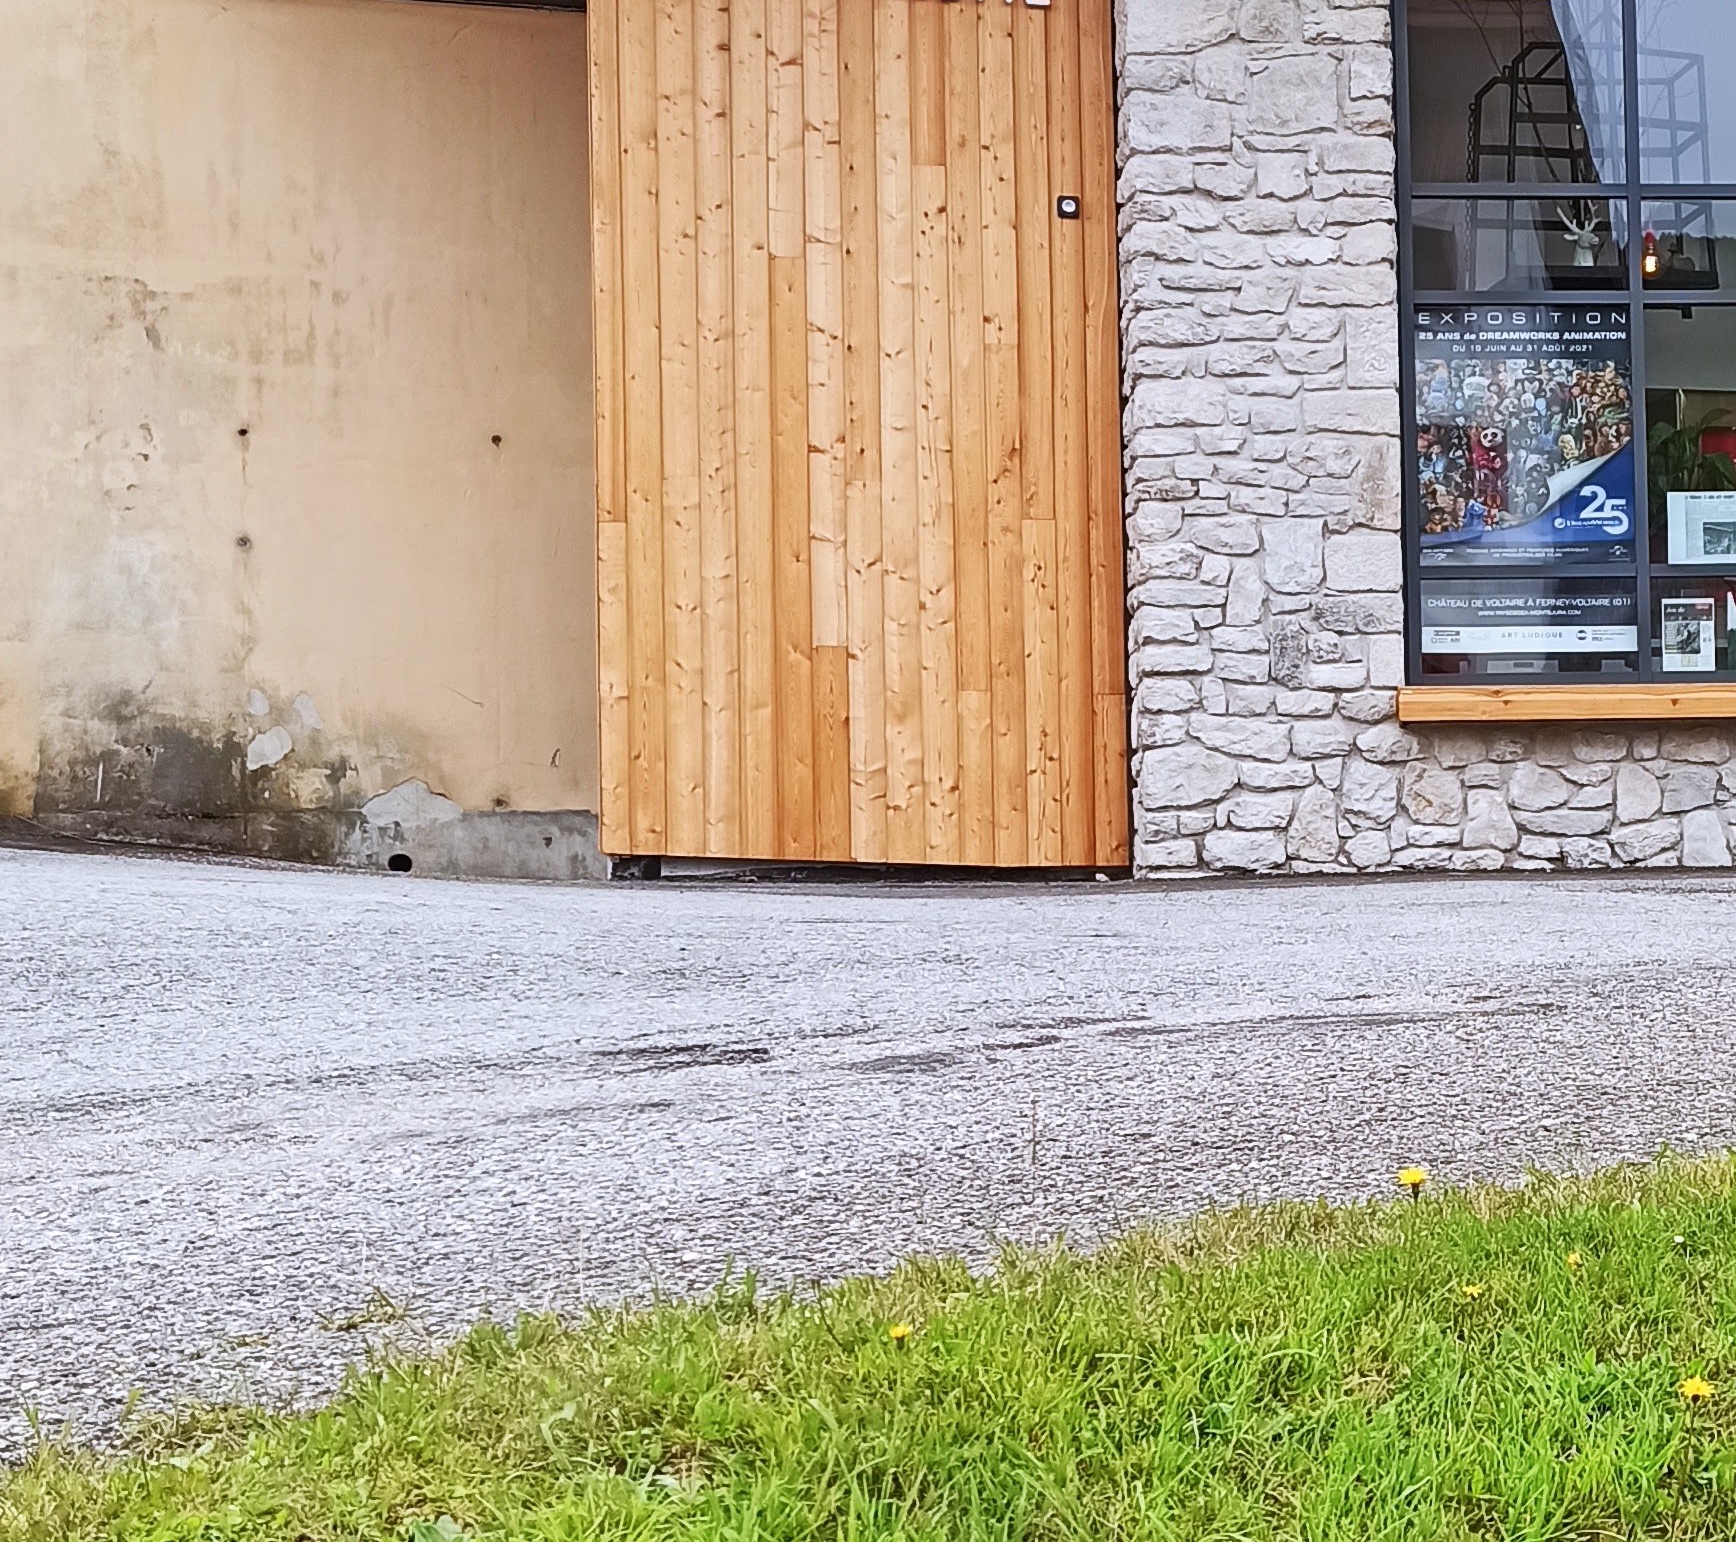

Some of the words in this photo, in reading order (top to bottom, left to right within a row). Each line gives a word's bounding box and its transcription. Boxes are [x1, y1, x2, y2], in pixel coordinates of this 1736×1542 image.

[1418, 311, 1627, 325] EXPOSITION
[1419, 332, 1433, 340] 25
[1437, 332, 1460, 340] ANS
[1479, 331, 1560, 340] DREAMWORKS
[1563, 331, 1627, 340] ANIMATION
[1484, 344, 1507, 352] JUIN
[1510, 344, 1523, 352] AU
[1579, 485, 1629, 535] 25
[1427, 597, 1469, 608] CHÂTEAU
[1472, 599, 1483, 608] DE
[1485, 598, 1525, 608] VOLTAIRE
[1536, 598, 1611, 607] FERNEY-VOLTAIRE
